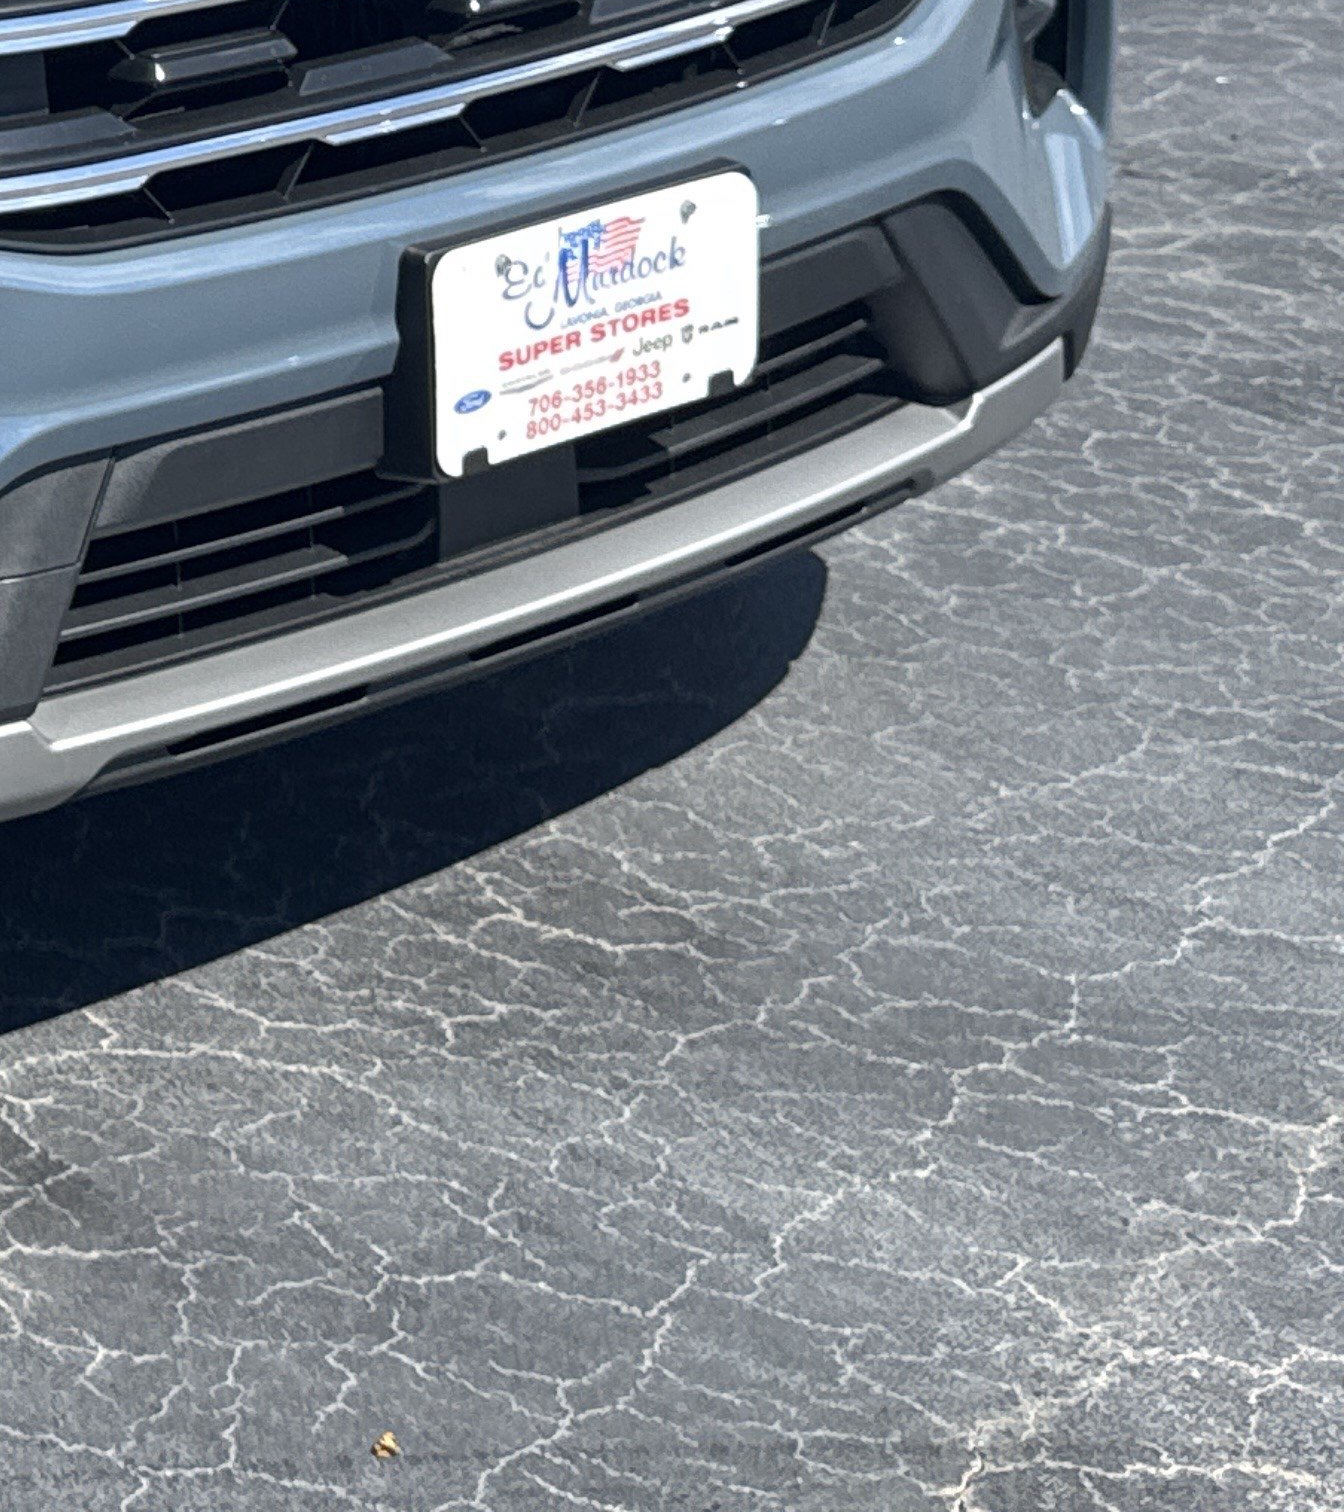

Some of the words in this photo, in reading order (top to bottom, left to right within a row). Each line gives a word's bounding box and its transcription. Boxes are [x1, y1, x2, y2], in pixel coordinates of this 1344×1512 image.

[498, 330, 582, 372] SUPER
[590, 297, 691, 343] STORES
[632, 333, 674, 357] Jeep
[525, 380, 664, 441] 800-453-3433
[528, 359, 662, 418] 706-356-1933
